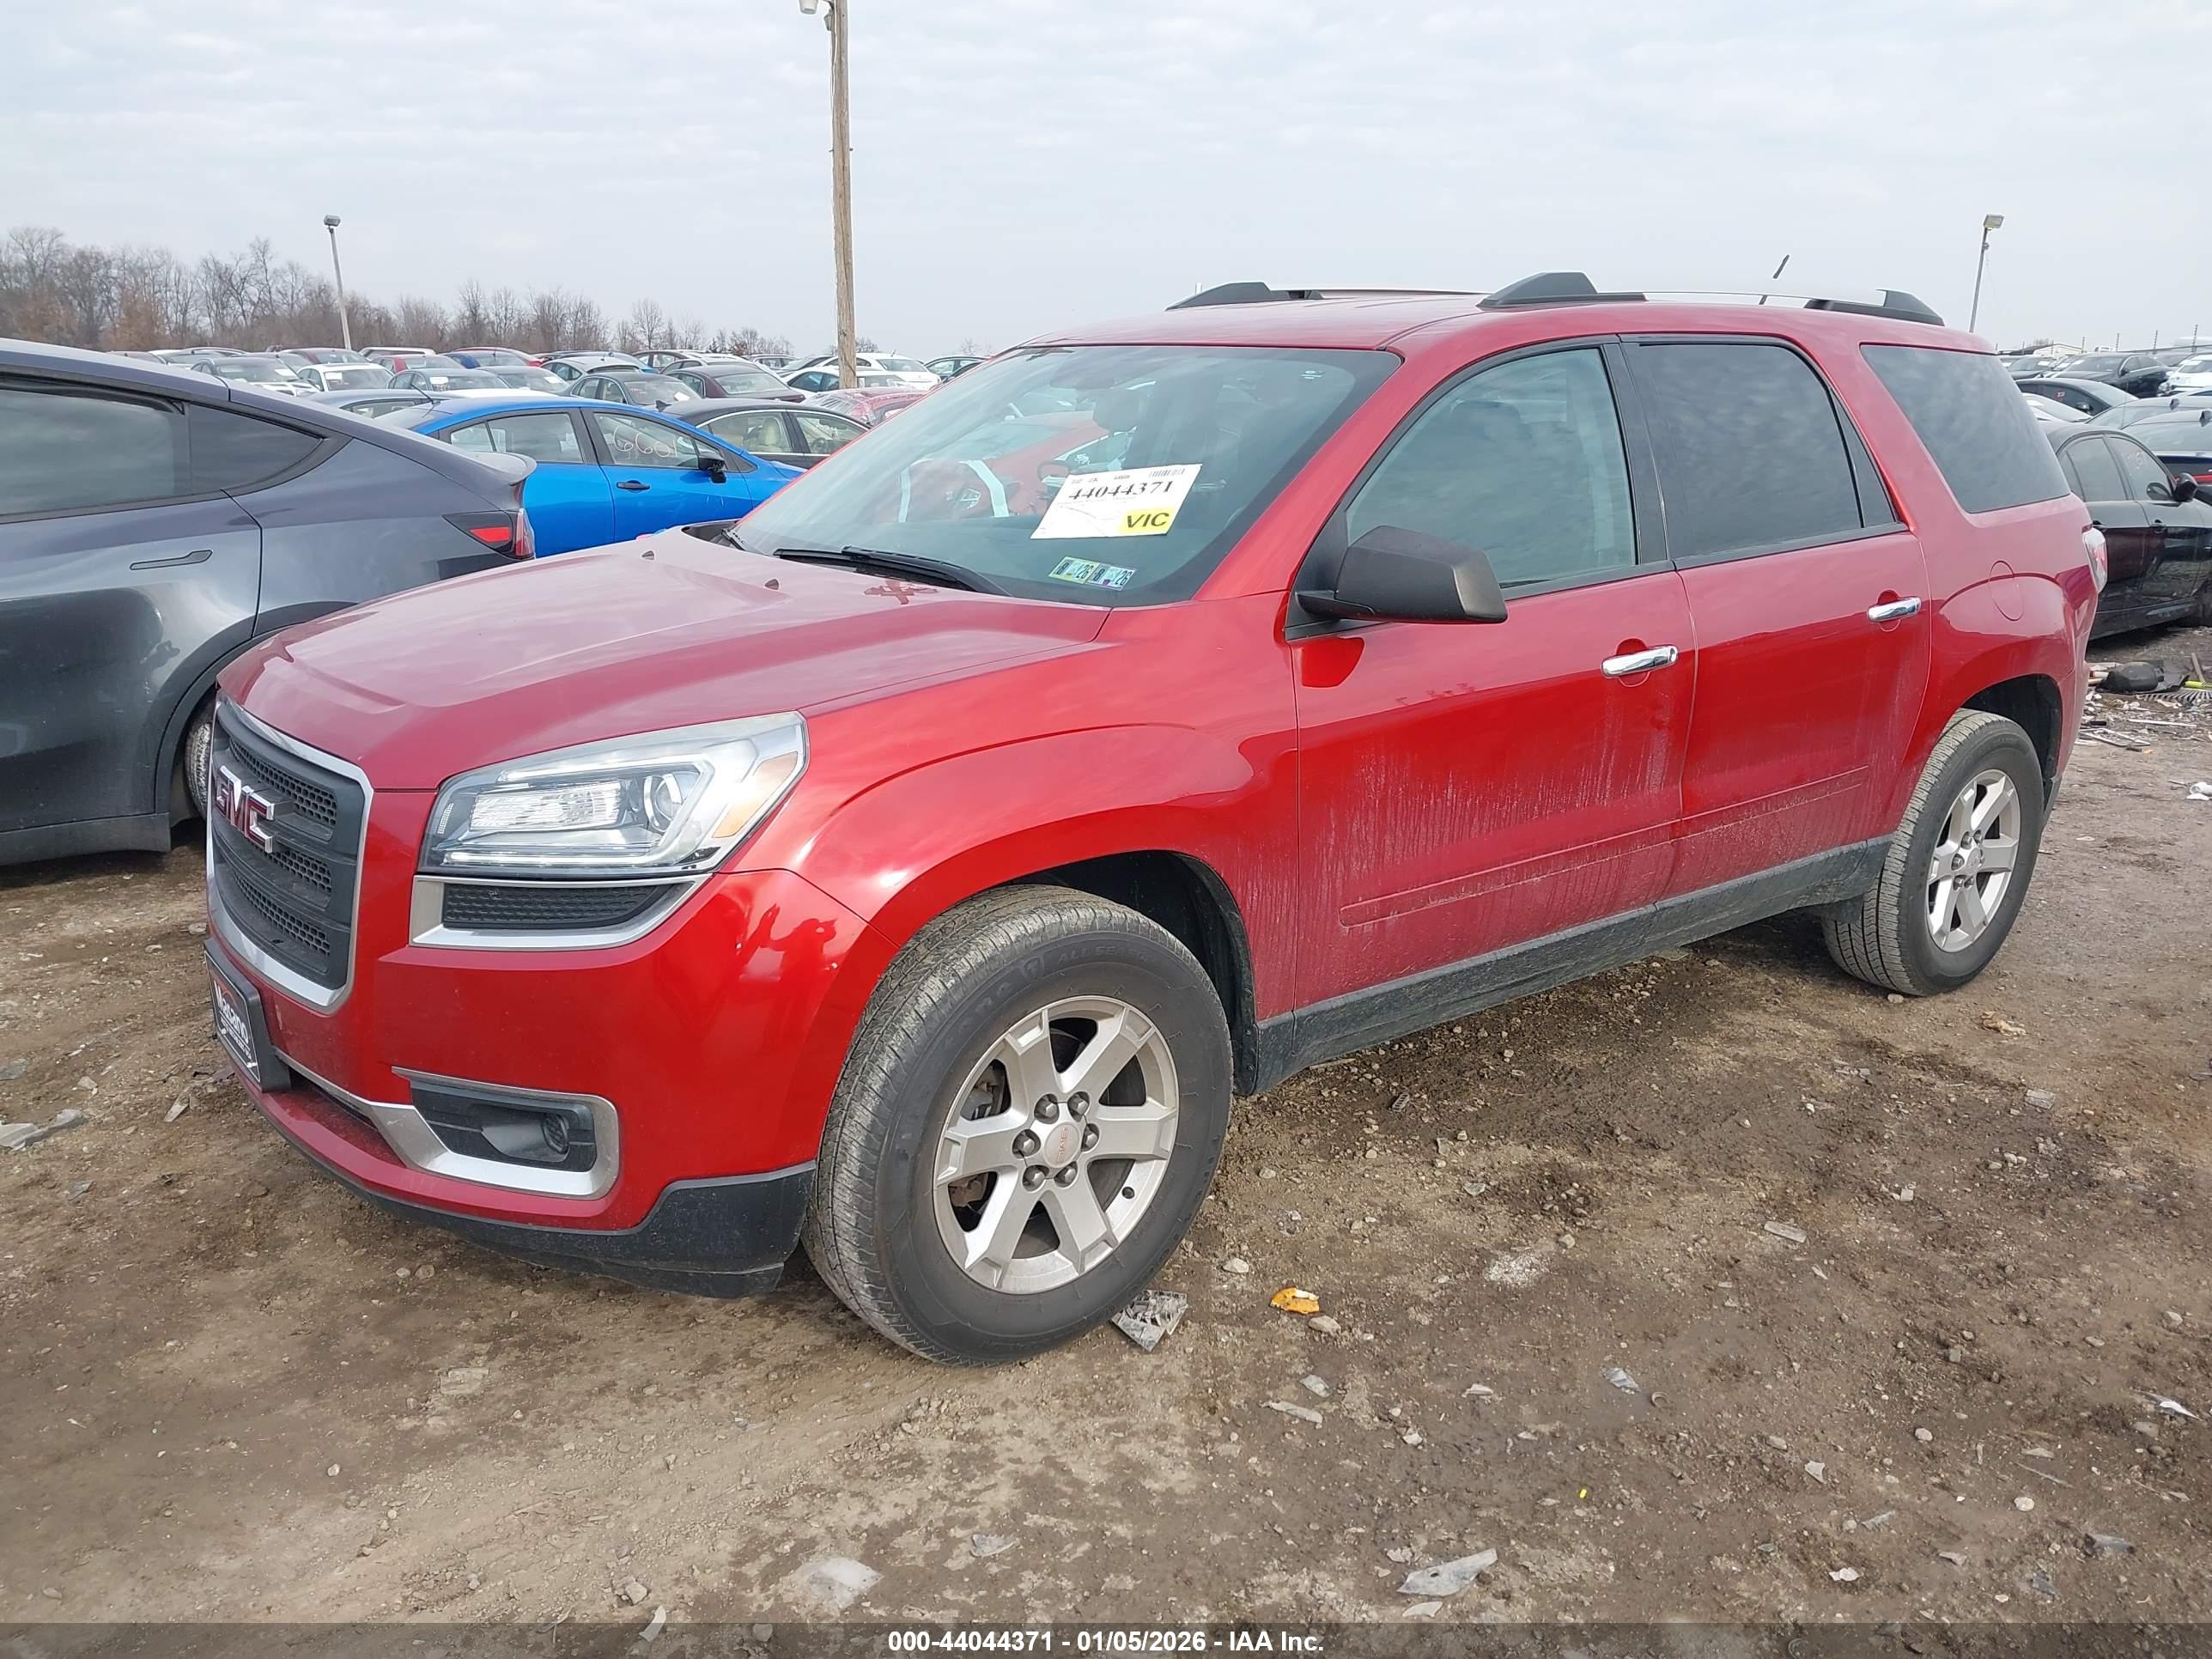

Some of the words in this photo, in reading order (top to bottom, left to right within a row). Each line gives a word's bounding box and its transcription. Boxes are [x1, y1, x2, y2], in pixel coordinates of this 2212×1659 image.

[613, 425, 678, 458] 6601
[1068, 481, 1174, 501] 44044371
[1127, 513, 1170, 529] VIC
[216, 765, 275, 854] GMC
